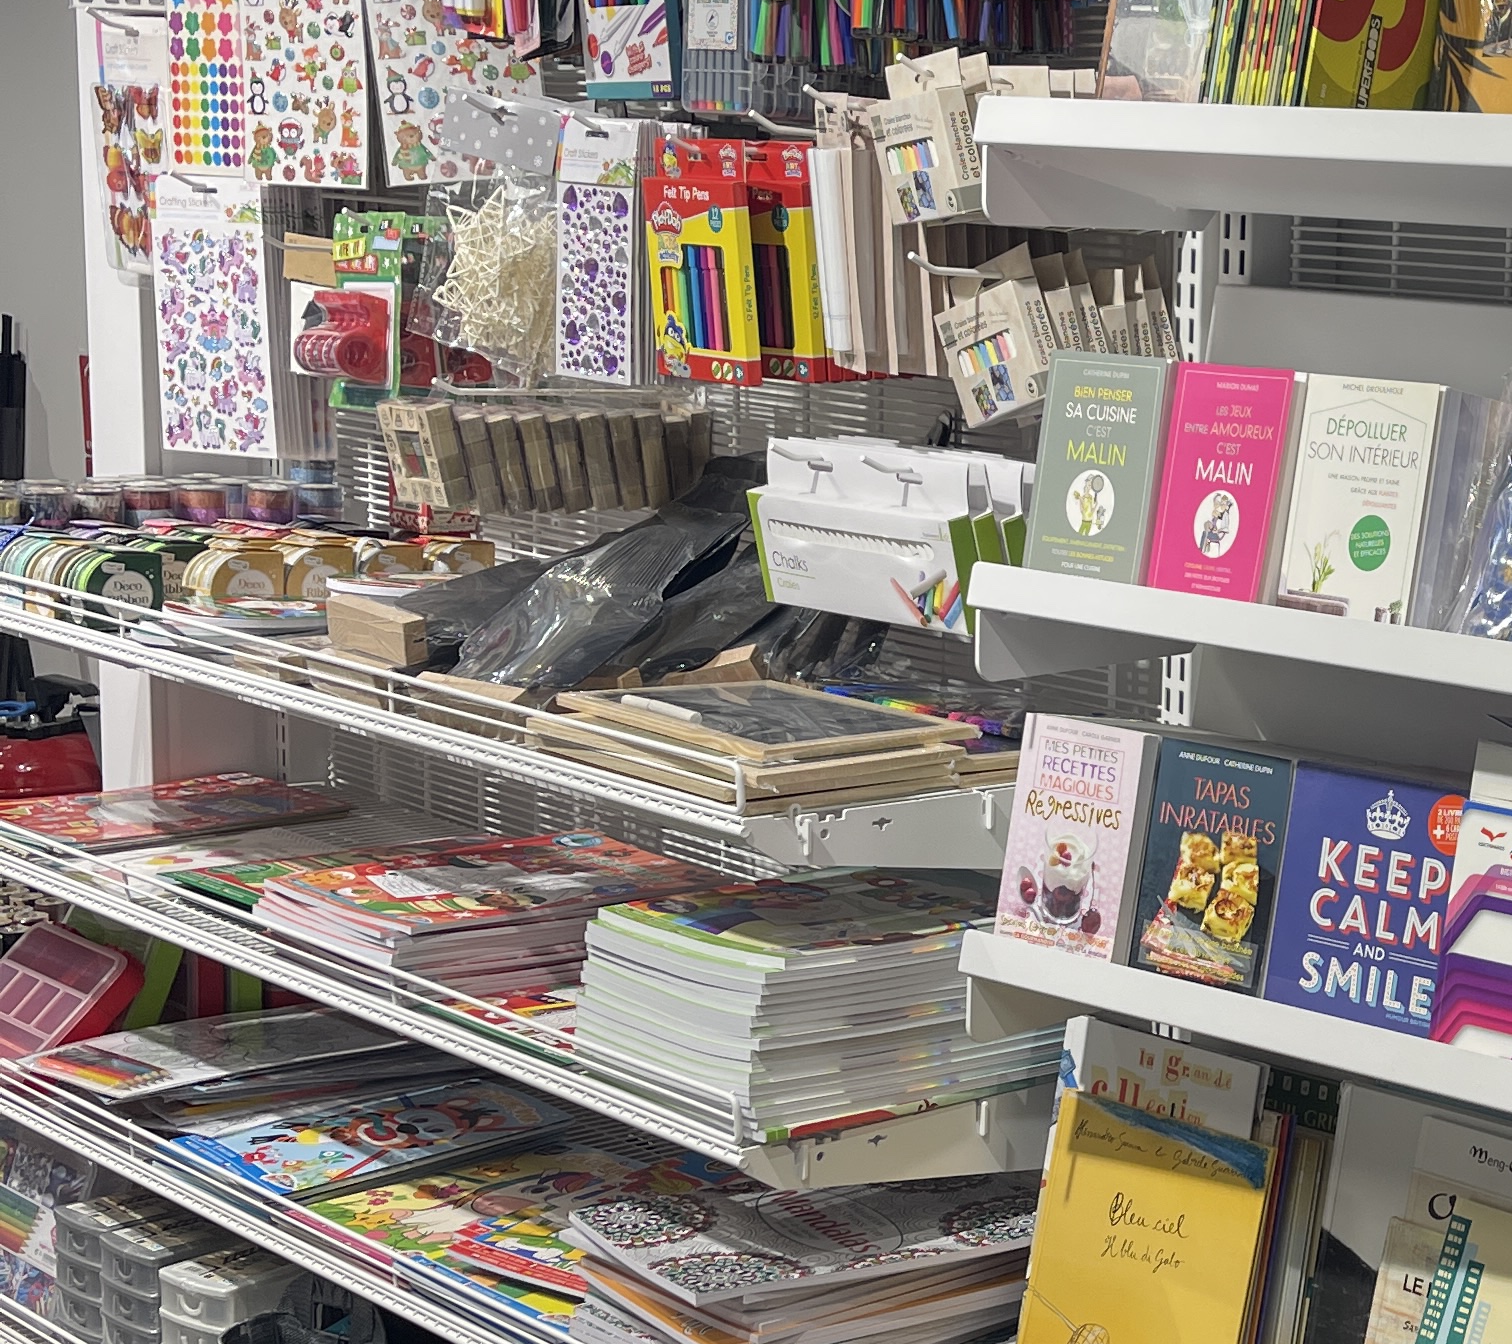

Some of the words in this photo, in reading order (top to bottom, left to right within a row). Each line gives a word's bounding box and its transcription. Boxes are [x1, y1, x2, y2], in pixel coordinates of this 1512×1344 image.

[663, 185, 677, 199] Felt
[678, 186, 690, 202] Tip
[692, 187, 709, 201] Pens
[1074, 384, 1097, 400] BIEN
[1098, 387, 1133, 403] PENSER
[1064, 401, 1085, 419] SA
[1086, 403, 1137, 425] CUISINE
[1325, 416, 1408, 442] DÉPOLLUER
[1066, 439, 1126, 468] MALIN
[1309, 440, 1343, 461] SON
[1346, 442, 1419, 471] INTÉRIEUR
[1194, 457, 1254, 487] MALIN
[772, 550, 809, 573] Chalks
[1045, 739, 1069, 755] MES
[1072, 743, 1118, 764] PETITES
[1042, 754, 1117, 783] RECETTES
[1039, 773, 1114, 801] MAGIQUES
[1193, 776, 1251, 810] TAPAS
[1317, 836, 1451, 906] KEEP
[1308, 886, 1442, 956] CALM
[1352, 944, 1385, 962] AND
[771, 1186, 886, 1254] Mandalas
